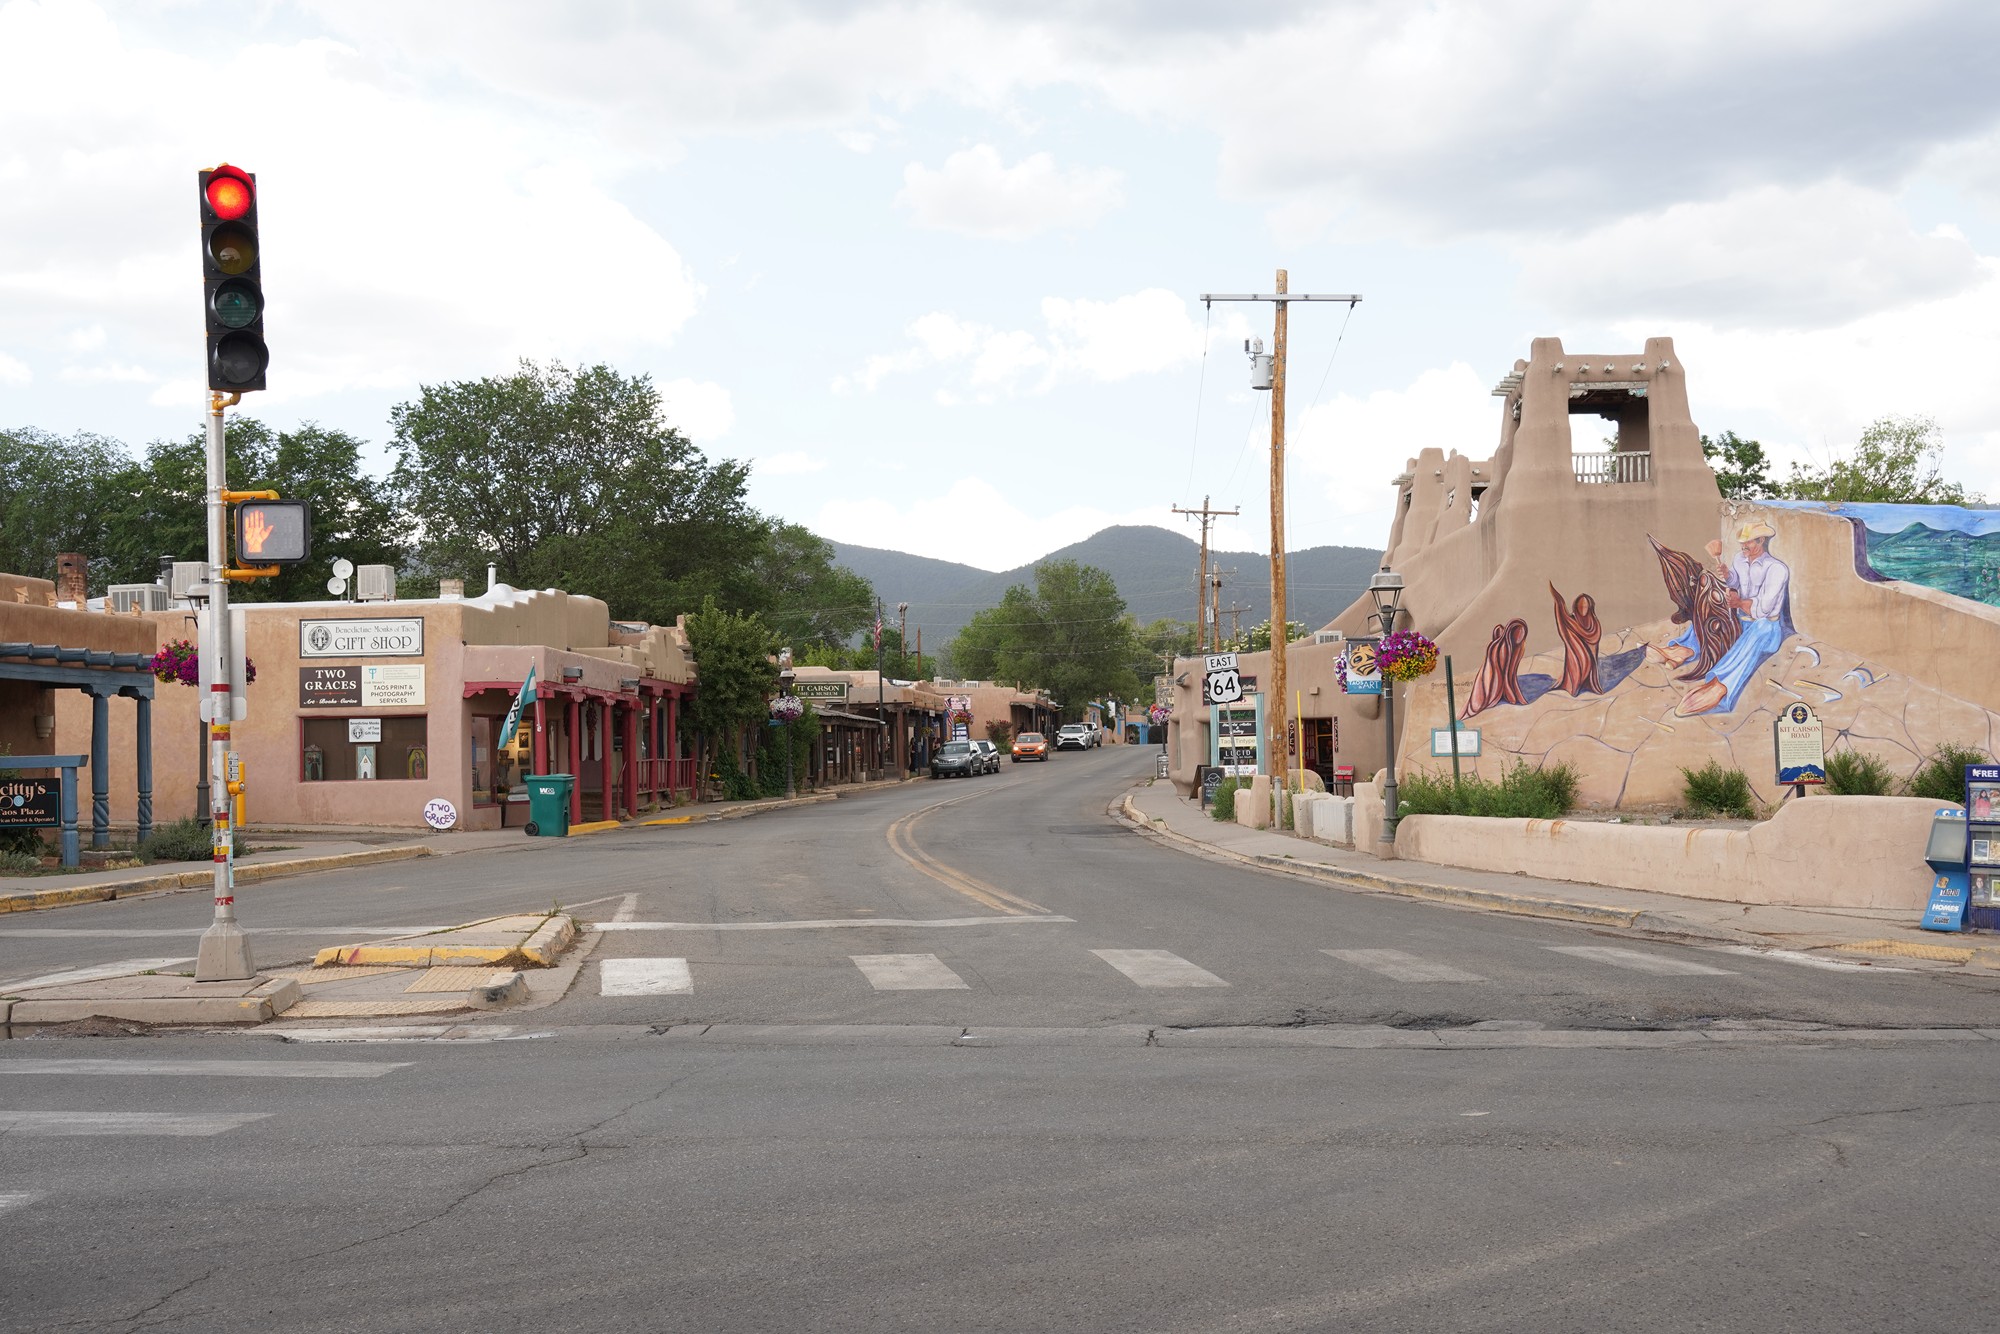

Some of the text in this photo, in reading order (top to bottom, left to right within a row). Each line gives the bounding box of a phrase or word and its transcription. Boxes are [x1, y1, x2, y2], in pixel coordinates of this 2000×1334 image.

[335, 636, 412, 650] GIFT SHOP
[1210, 656, 1232, 669] EAST
[315, 669, 346, 679] TWO
[304, 681, 357, 691] GRACES
[1213, 676, 1236, 696] 64
[1363, 681, 1379, 689] ART
[1978, 769, 1999, 778] FREE
[0, 808, 18, 816] aos
[429, 803, 450, 813] TWO
[424, 810, 456, 826] GRACES
[1931, 902, 1960, 913] HOMES
